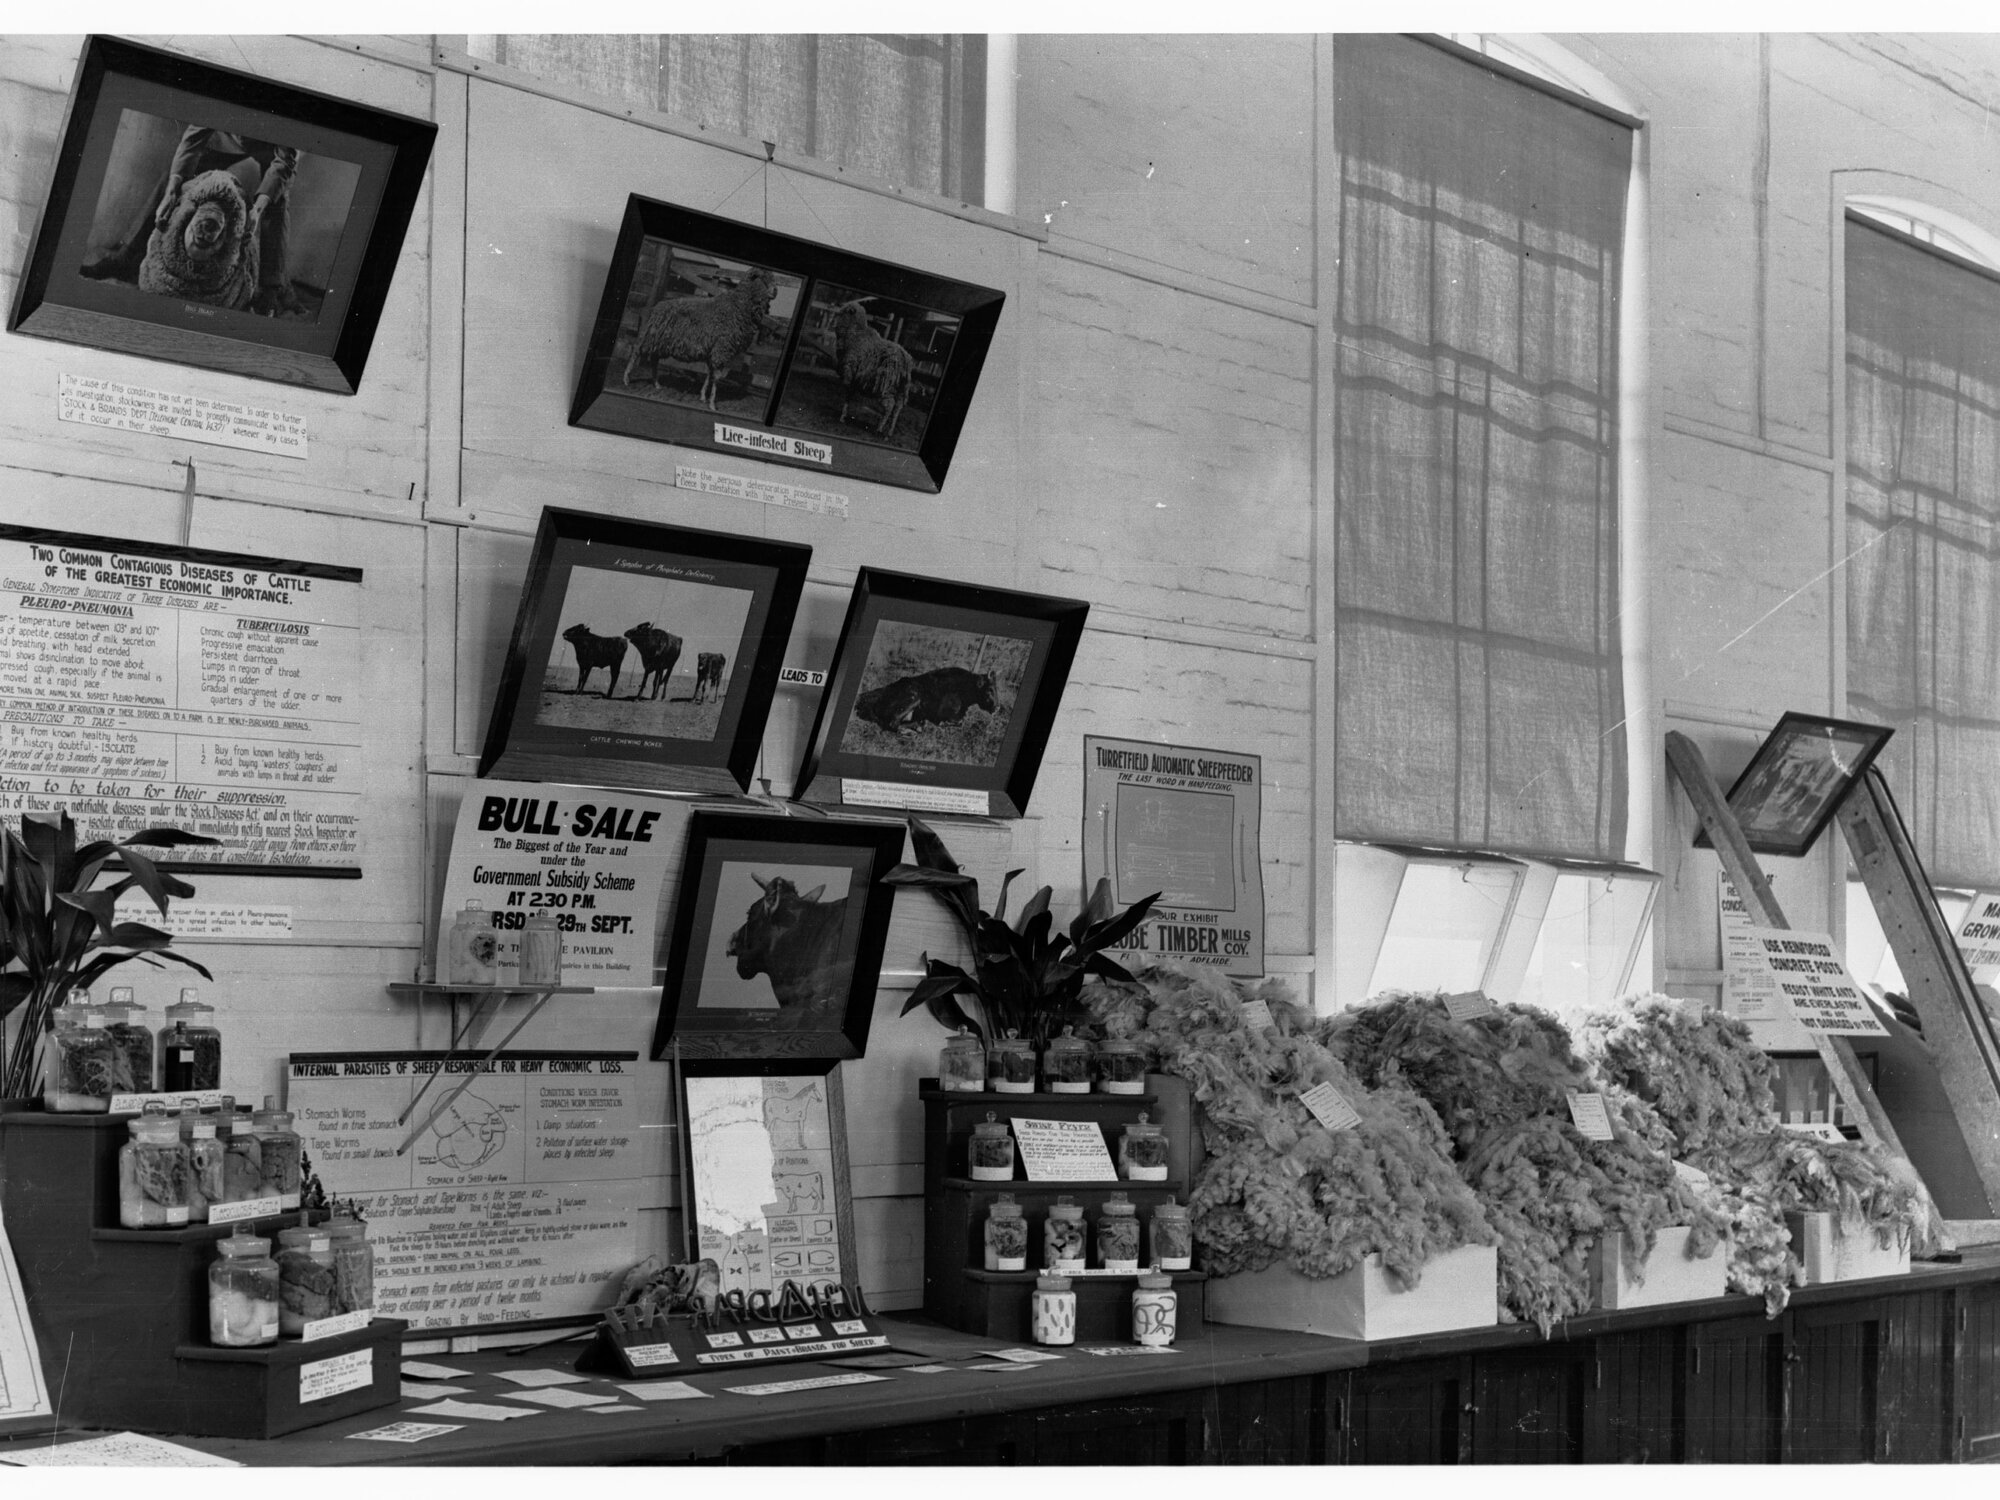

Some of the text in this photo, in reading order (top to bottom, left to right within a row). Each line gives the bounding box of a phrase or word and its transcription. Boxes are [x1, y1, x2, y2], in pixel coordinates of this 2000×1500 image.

[66, 375, 77, 386] The
[80, 380, 98, 390] cause
[101, 382, 108, 391] of
[111, 383, 124, 394] this
[127, 387, 155, 399] condition
[171, 394, 180, 404] not
[196, 397, 209, 408] been
[247, 406, 253, 416] In
[255, 408, 269, 418] order
[273, 410, 279, 420] to
[282, 412, 301, 424] further
[65, 410, 72, 420] of
[78, 412, 84, 422] it
[90, 416, 111, 426] occur
[117, 420, 123, 428] in
[129, 420, 144, 431] their
[723, 428, 825, 460] Lice-infested Sheep
[30, 544, 310, 592] TWO COMMON CONTAGIOUS DISEASES OF CATTLE
[45, 564, 291, 605] OF THE GREATEST ECONOMIC IMPORTANCE.
[2, 578, 218, 610] GENERAL SYMPTOMS INDICATIVE OF THESE DISEASES ARE
[20, 596, 133, 617] PLEURO-PNEUMONIA
[19, 614, 70, 628] temperature
[75, 618, 109, 630] between
[130, 623, 141, 633] and
[237, 618, 309, 634] TUBERCULOSIS
[201, 639, 284, 654] Progressive emaciation
[201, 650, 237, 662] Persistent
[201, 661, 225, 675] Lumps
[238, 666, 260, 677] region
[264, 667, 272, 676] of
[781, 671, 822, 685] LEADS TO
[3, 710, 114, 727] PRECAUTIONS TO TAKE
[590, 736, 610, 744] CATTLE
[1096, 746, 1252, 783] TURRETFIELD AUTOMATIC SHEEPFEEDER
[1118, 771, 1132, 782] THE
[1135, 773, 1152, 784] LAST
[1156, 775, 1176, 786] WORD
[1178, 777, 1186, 787] IN
[44, 780, 59, 793] to
[70, 781, 84, 794] be
[97, 782, 130, 796] taken
[144, 785, 164, 798] for
[174, 786, 206, 800] their
[477, 797, 661, 842] BULL SALE
[494, 837, 627, 856] The Biggest of the Year and
[540, 854, 585, 866] under the
[473, 865, 634, 893] Government Subsidy Scheme
[507, 891, 525, 906] AT
[591, 915, 633, 934] SEPT.
[1183, 911, 1217, 924] EXHIBIT
[1157, 926, 1218, 954] TIMBER
[1222, 928, 1250, 942] MILLS
[573, 945, 613, 955] PAVILION
[1224, 942, 1248, 956] COY.
[1763, 939, 1831, 957] USE REINFORCED
[1769, 958, 1843, 975] CONCRETE POSTS
[1782, 983, 1856, 998] RESIST WHITE ANTS
[1793, 998, 1861, 1010] ARE EVERLASTING
[1800, 1018, 1818, 1028] NOT
[1816, 1018, 1854, 1029] DAMAGED
[1861, 1020, 1881, 1030] FIRE
[293, 1063, 339, 1076] INTERNAL
[344, 1063, 390, 1076] PARASITES
[396, 1063, 407, 1075] OF
[501, 1062, 515, 1074] FOR
[520, 1061, 543, 1074] HEAVY
[549, 1061, 591, 1074] ECONOMIC
[600, 1061, 623, 1073] LOSS.
[305, 1109, 365, 1119] Stomach Worms
[319, 1121, 338, 1130] found
[351, 1120, 365, 1130] true
[368, 1119, 399, 1130] stomach
[1024, 1121, 1090, 1130] SWINE FEVER
[312, 1138, 359, 1151] Tape Worms
[709, 1354, 735, 1362] TYPES
